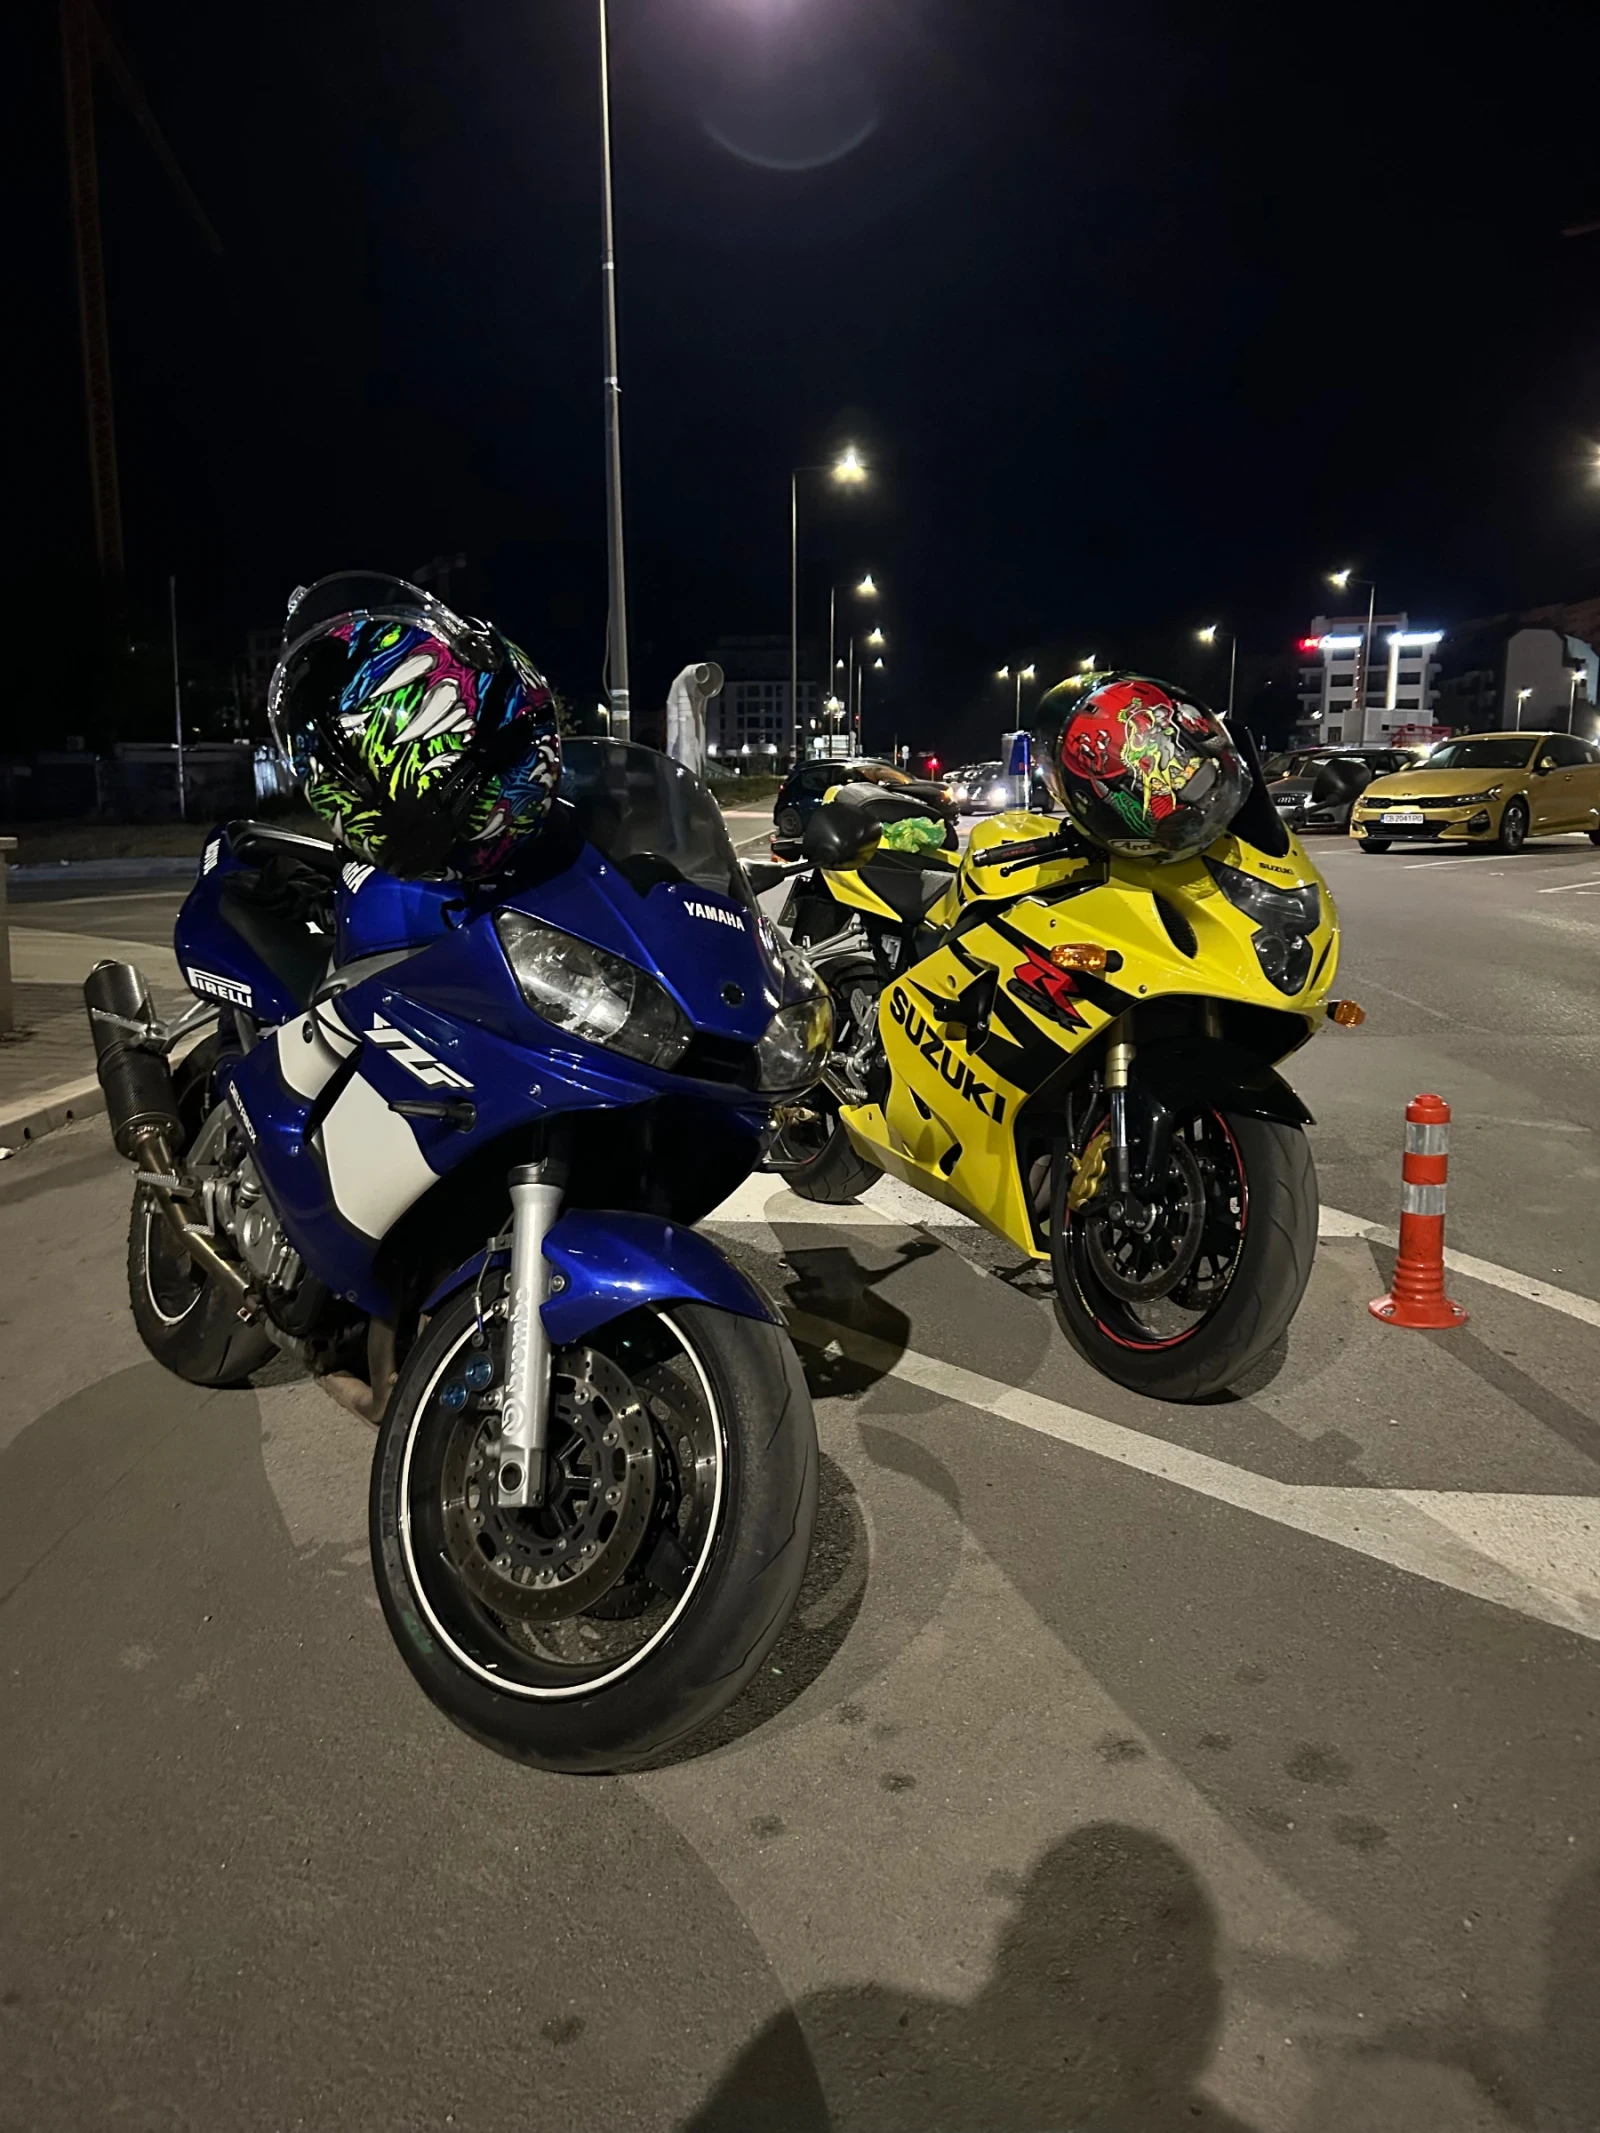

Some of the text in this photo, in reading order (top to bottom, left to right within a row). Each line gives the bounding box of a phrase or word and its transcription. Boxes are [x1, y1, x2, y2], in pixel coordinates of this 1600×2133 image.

[1259, 862, 1295, 875] SUZUKI
[683, 901, 745, 932] YAMAHA
[186, 967, 252, 1008] PIRELLI
[890, 986, 1006, 1125] SUZUKI
[228, 1080, 257, 1144] DELTABOX
[505, 1287, 530, 1393] brembo
